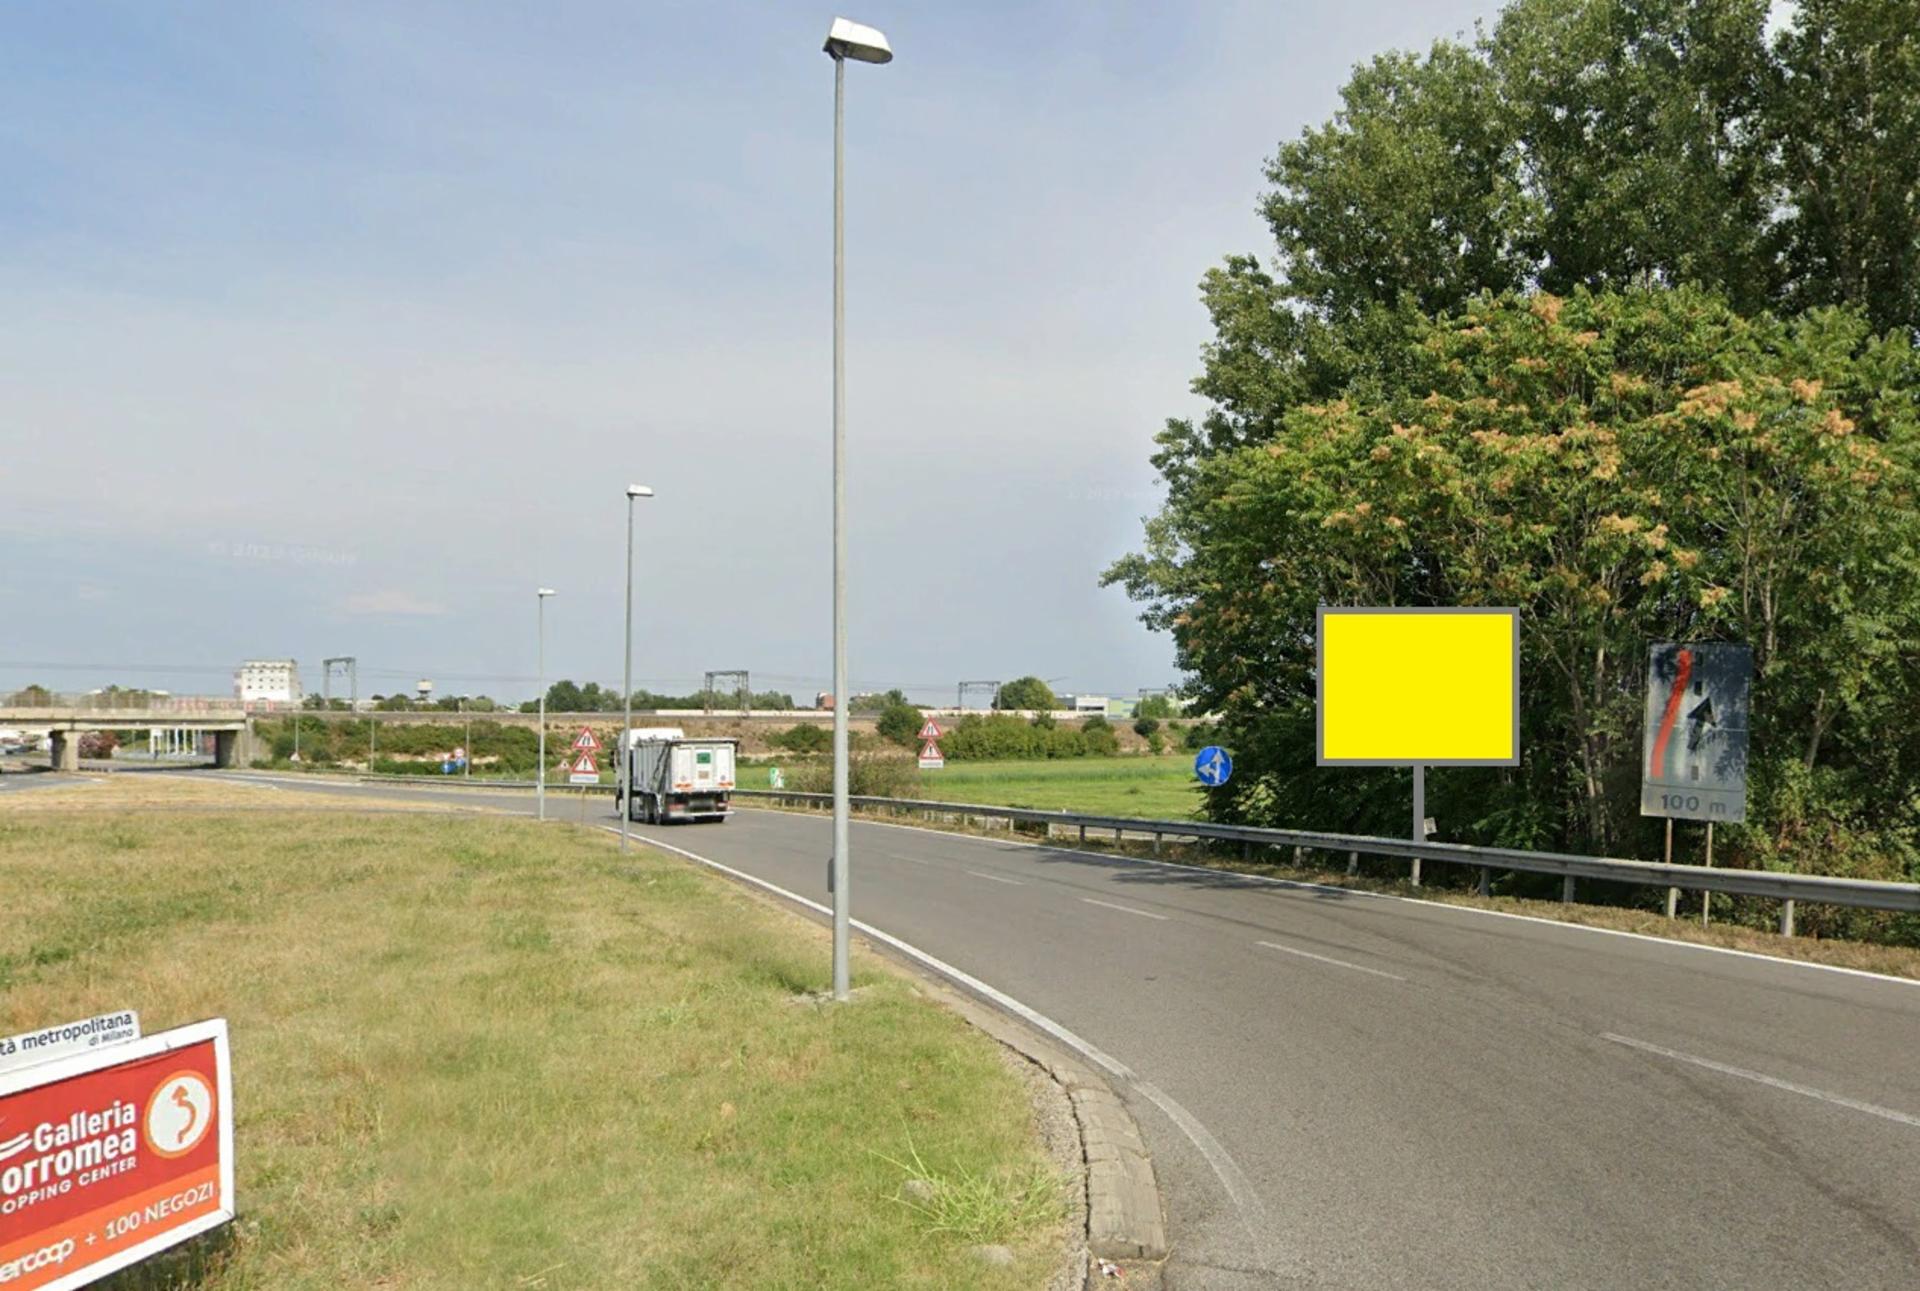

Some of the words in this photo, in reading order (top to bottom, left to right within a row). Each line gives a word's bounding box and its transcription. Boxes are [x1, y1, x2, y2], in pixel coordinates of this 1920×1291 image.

[1661, 794, 1699, 811] 100
[1709, 801, 1726, 814] m
[22, 1013, 132, 1050] metropolitana
[34, 1100, 136, 1152] Galleria
[2, 1128, 136, 1194] orromea
[2, 1179, 72, 1215] OPPING
[78, 1156, 137, 1186] CENTER
[85, 1231, 97, 1246] +
[106, 1211, 141, 1240] 100
[144, 1181, 214, 1224] NEGOZI
